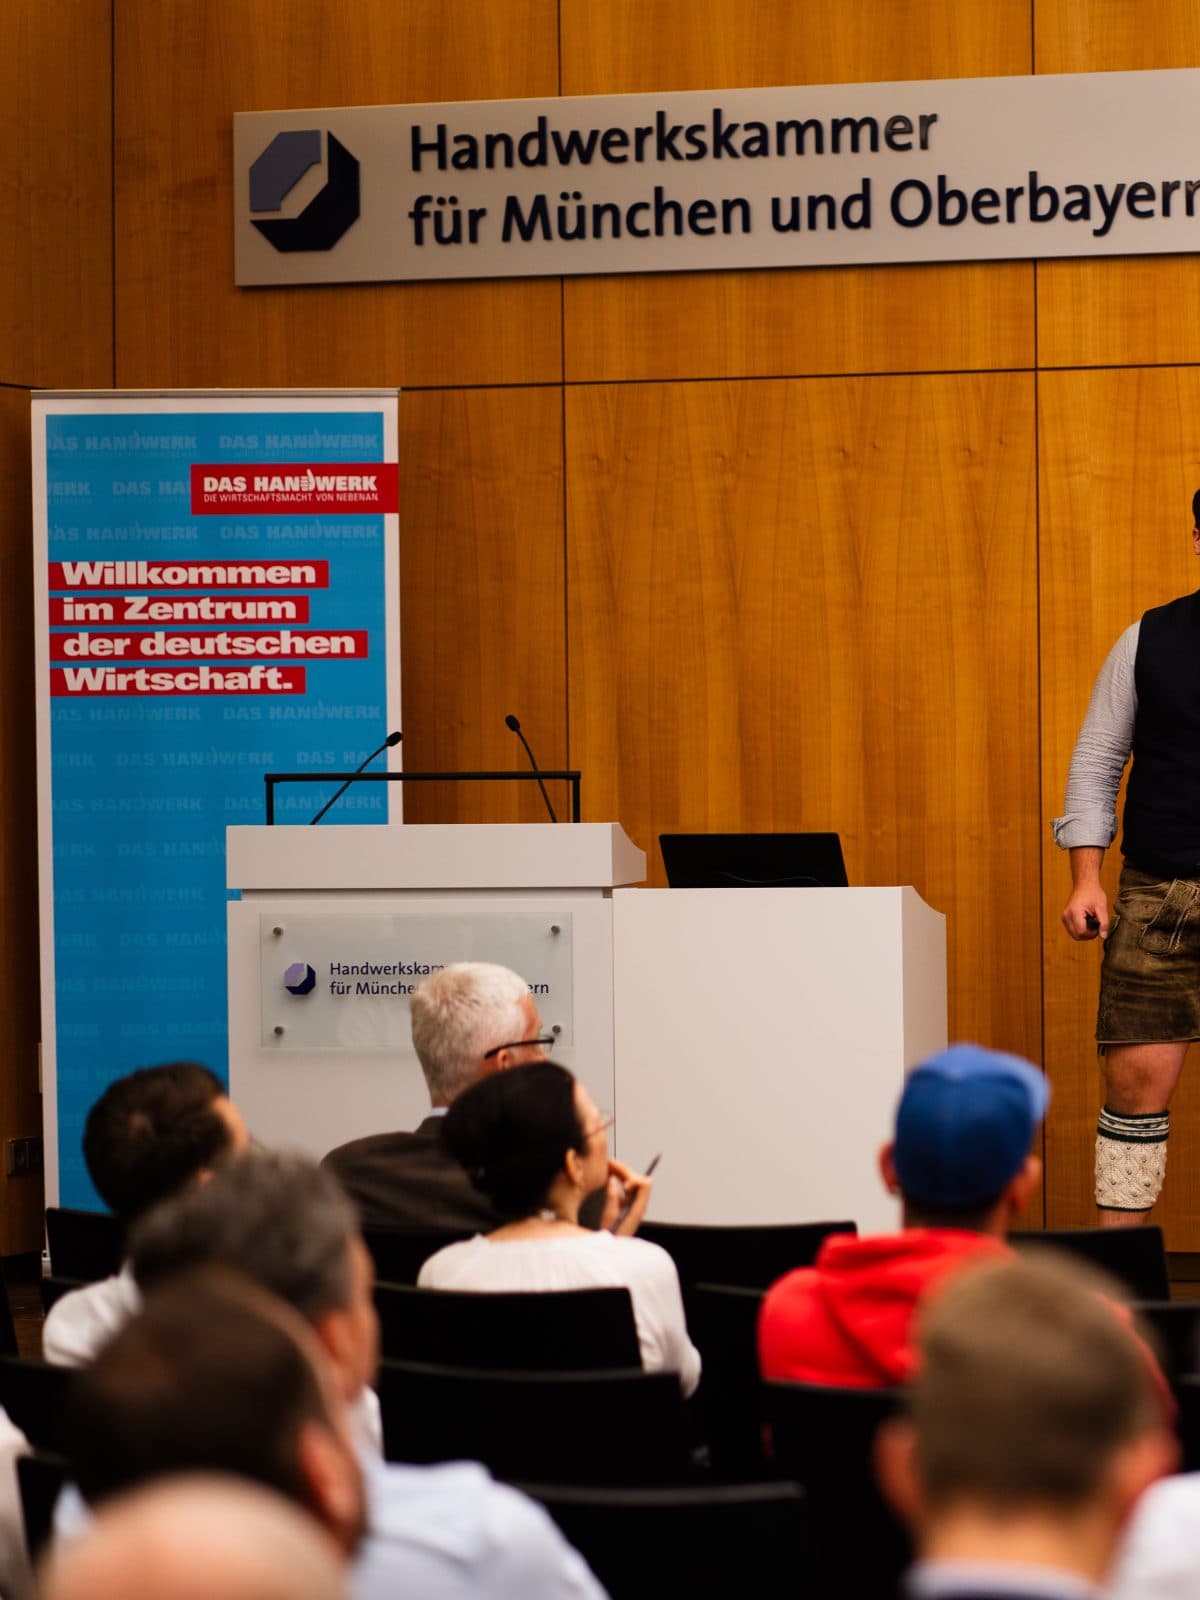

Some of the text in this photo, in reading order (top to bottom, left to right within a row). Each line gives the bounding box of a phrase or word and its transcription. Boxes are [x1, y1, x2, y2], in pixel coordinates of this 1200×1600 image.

[411, 109, 938, 172] Handwerkskammer
[408, 194, 487, 246] für
[501, 186, 751, 243] München
[771, 178, 873, 233] und
[219, 434, 258, 449] DAS
[203, 468, 378, 492] DAS HANDWERK
[203, 492, 379, 503] DIE WIRTSCHAFTSMACHT VON NEBENAN
[61, 561, 317, 586] Willkommen
[63, 596, 297, 621] im Zentrum
[63, 630, 356, 657] der deutschen
[63, 665, 293, 692] Wirtschaft.
[329, 961, 446, 976] Handwerkska
[329, 981, 415, 995] für Münche
